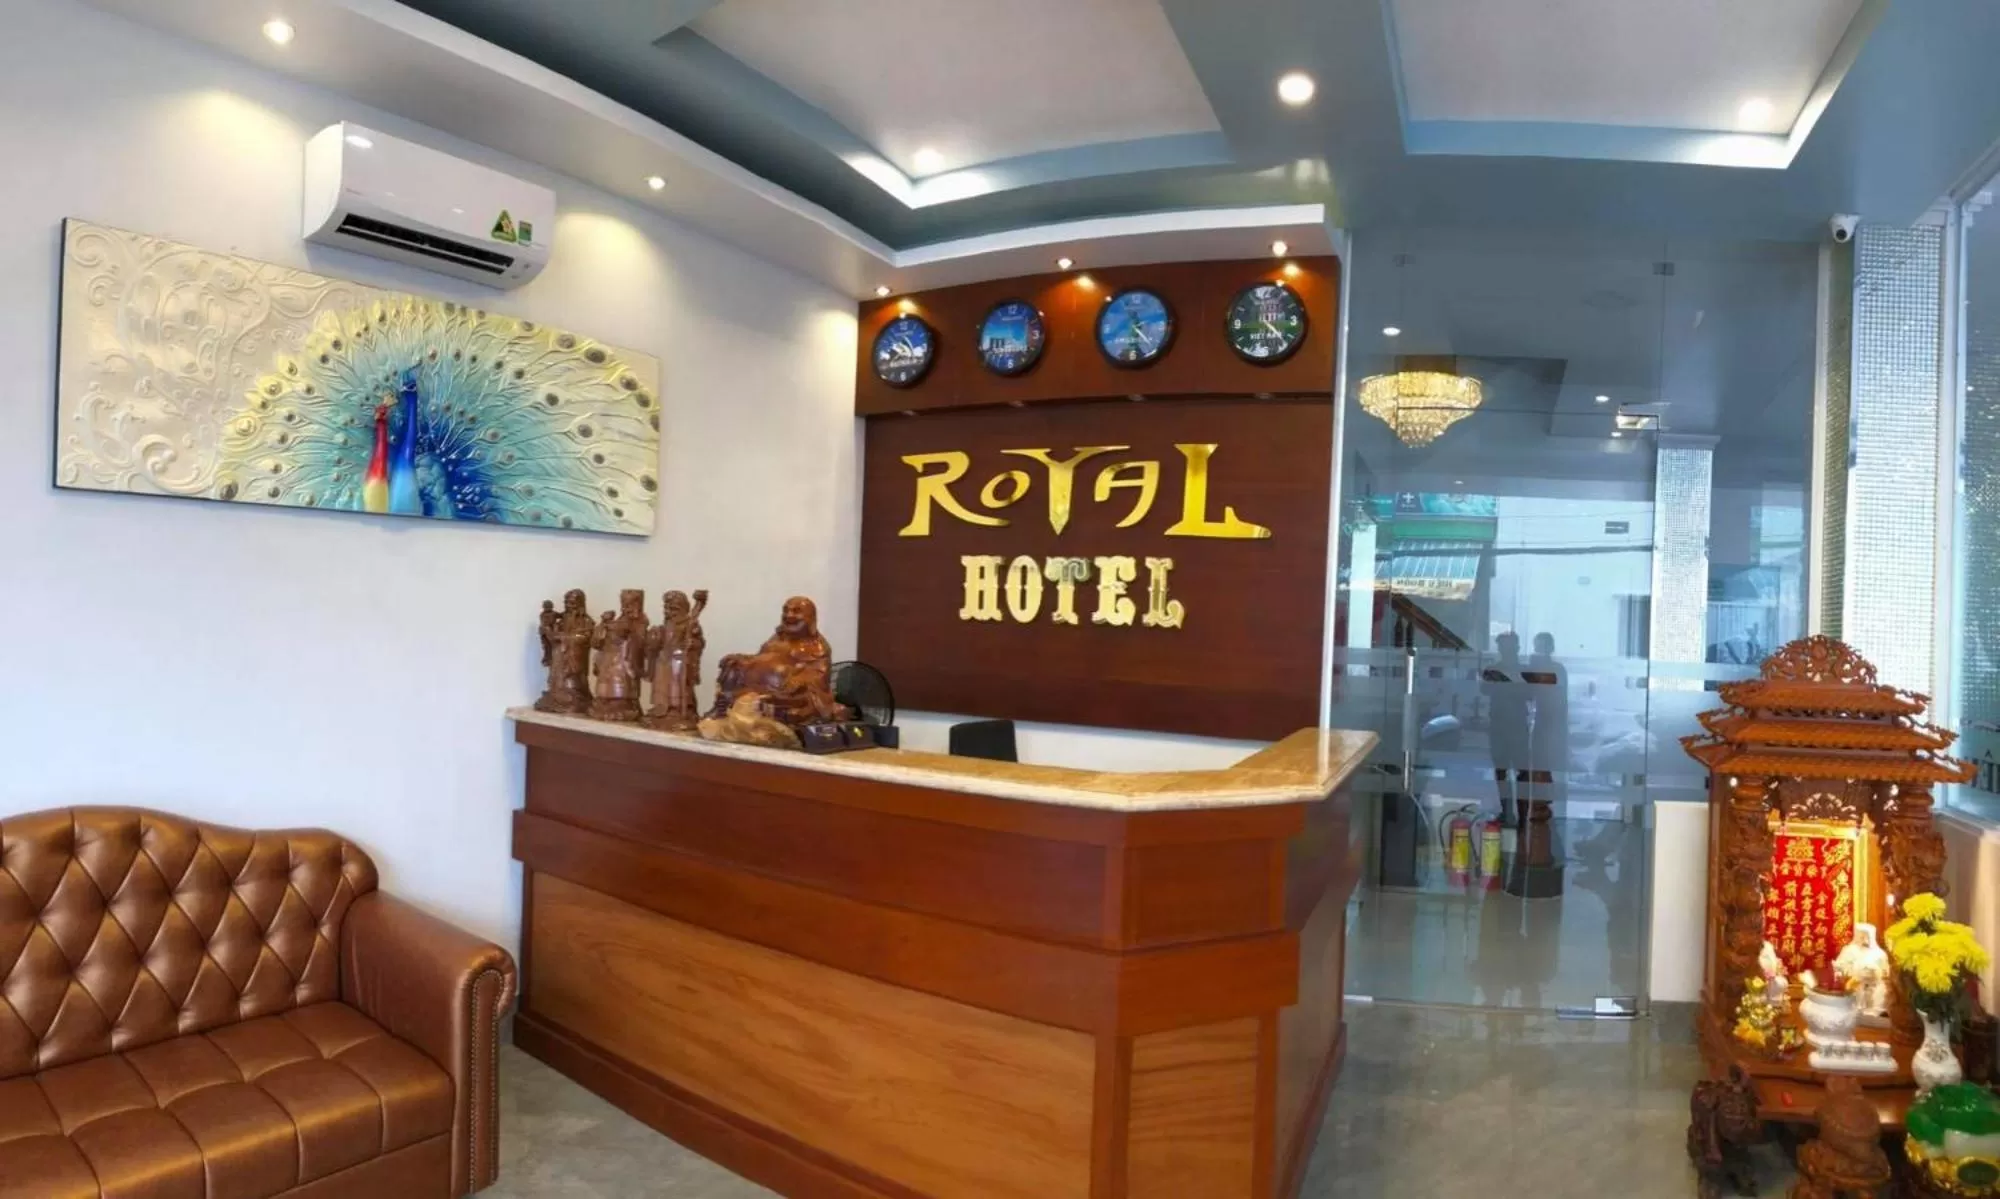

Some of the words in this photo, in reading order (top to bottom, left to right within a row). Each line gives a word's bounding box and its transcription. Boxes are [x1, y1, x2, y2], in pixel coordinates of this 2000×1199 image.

[1234, 319, 1242, 330] 9
[1289, 315, 1298, 326] 3
[898, 443, 1272, 539] ROYAL
[959, 555, 1184, 629] HOTEL
